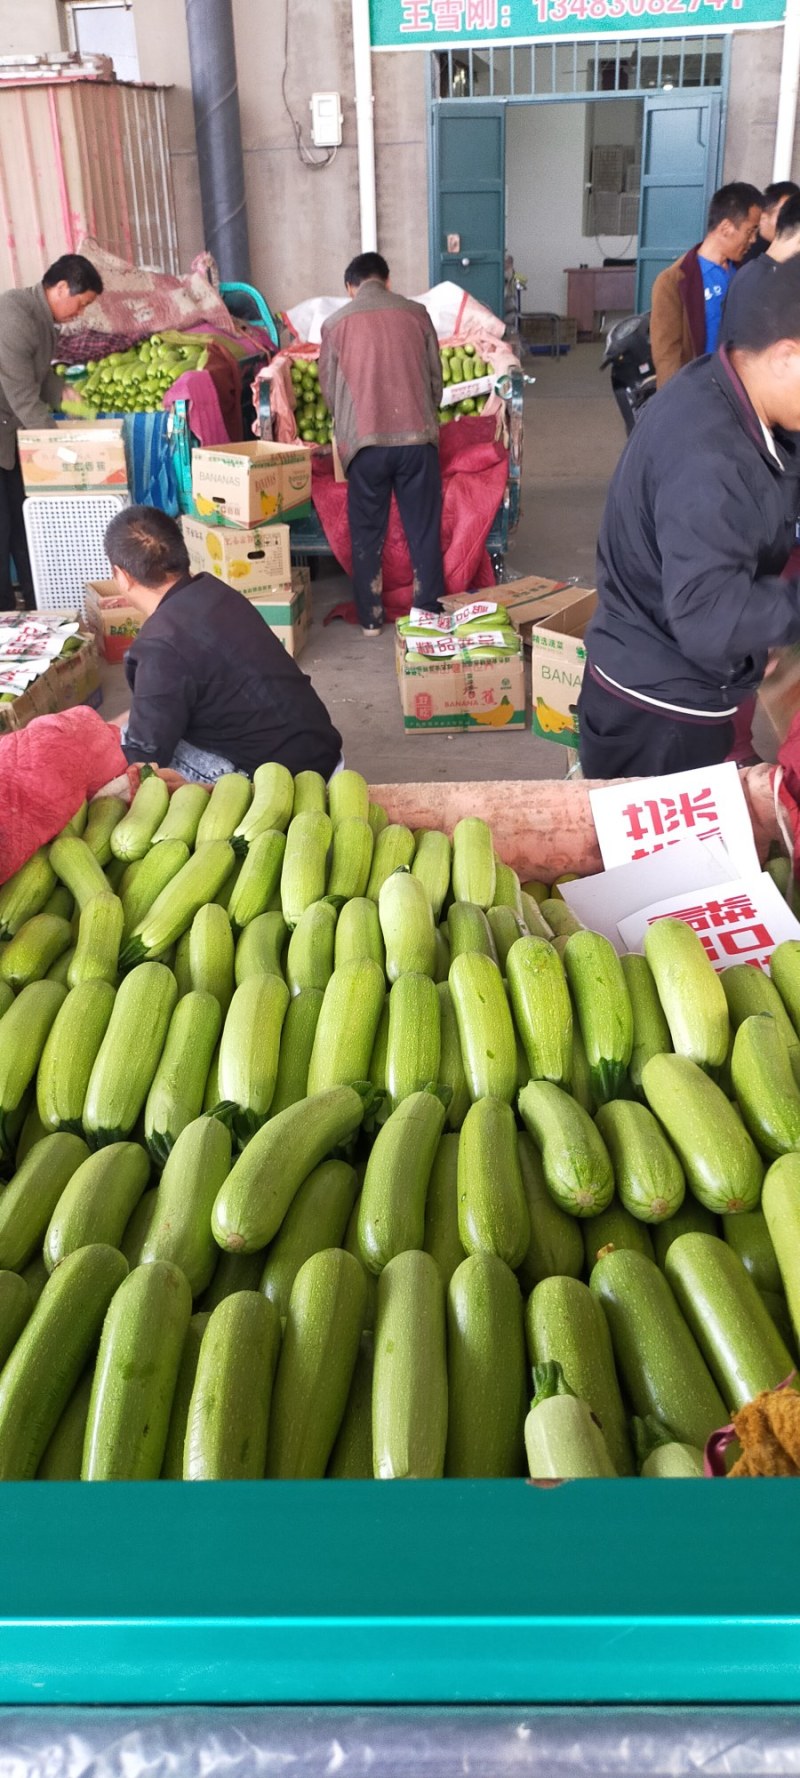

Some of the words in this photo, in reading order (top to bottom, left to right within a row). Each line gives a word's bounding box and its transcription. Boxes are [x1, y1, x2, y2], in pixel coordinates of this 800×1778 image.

[400, 0, 511, 32] 王雪刚：
[532, 0, 743, 22] 13483082
[199, 471, 241, 487] BANANAS
[444, 700, 479, 708] BANANA
